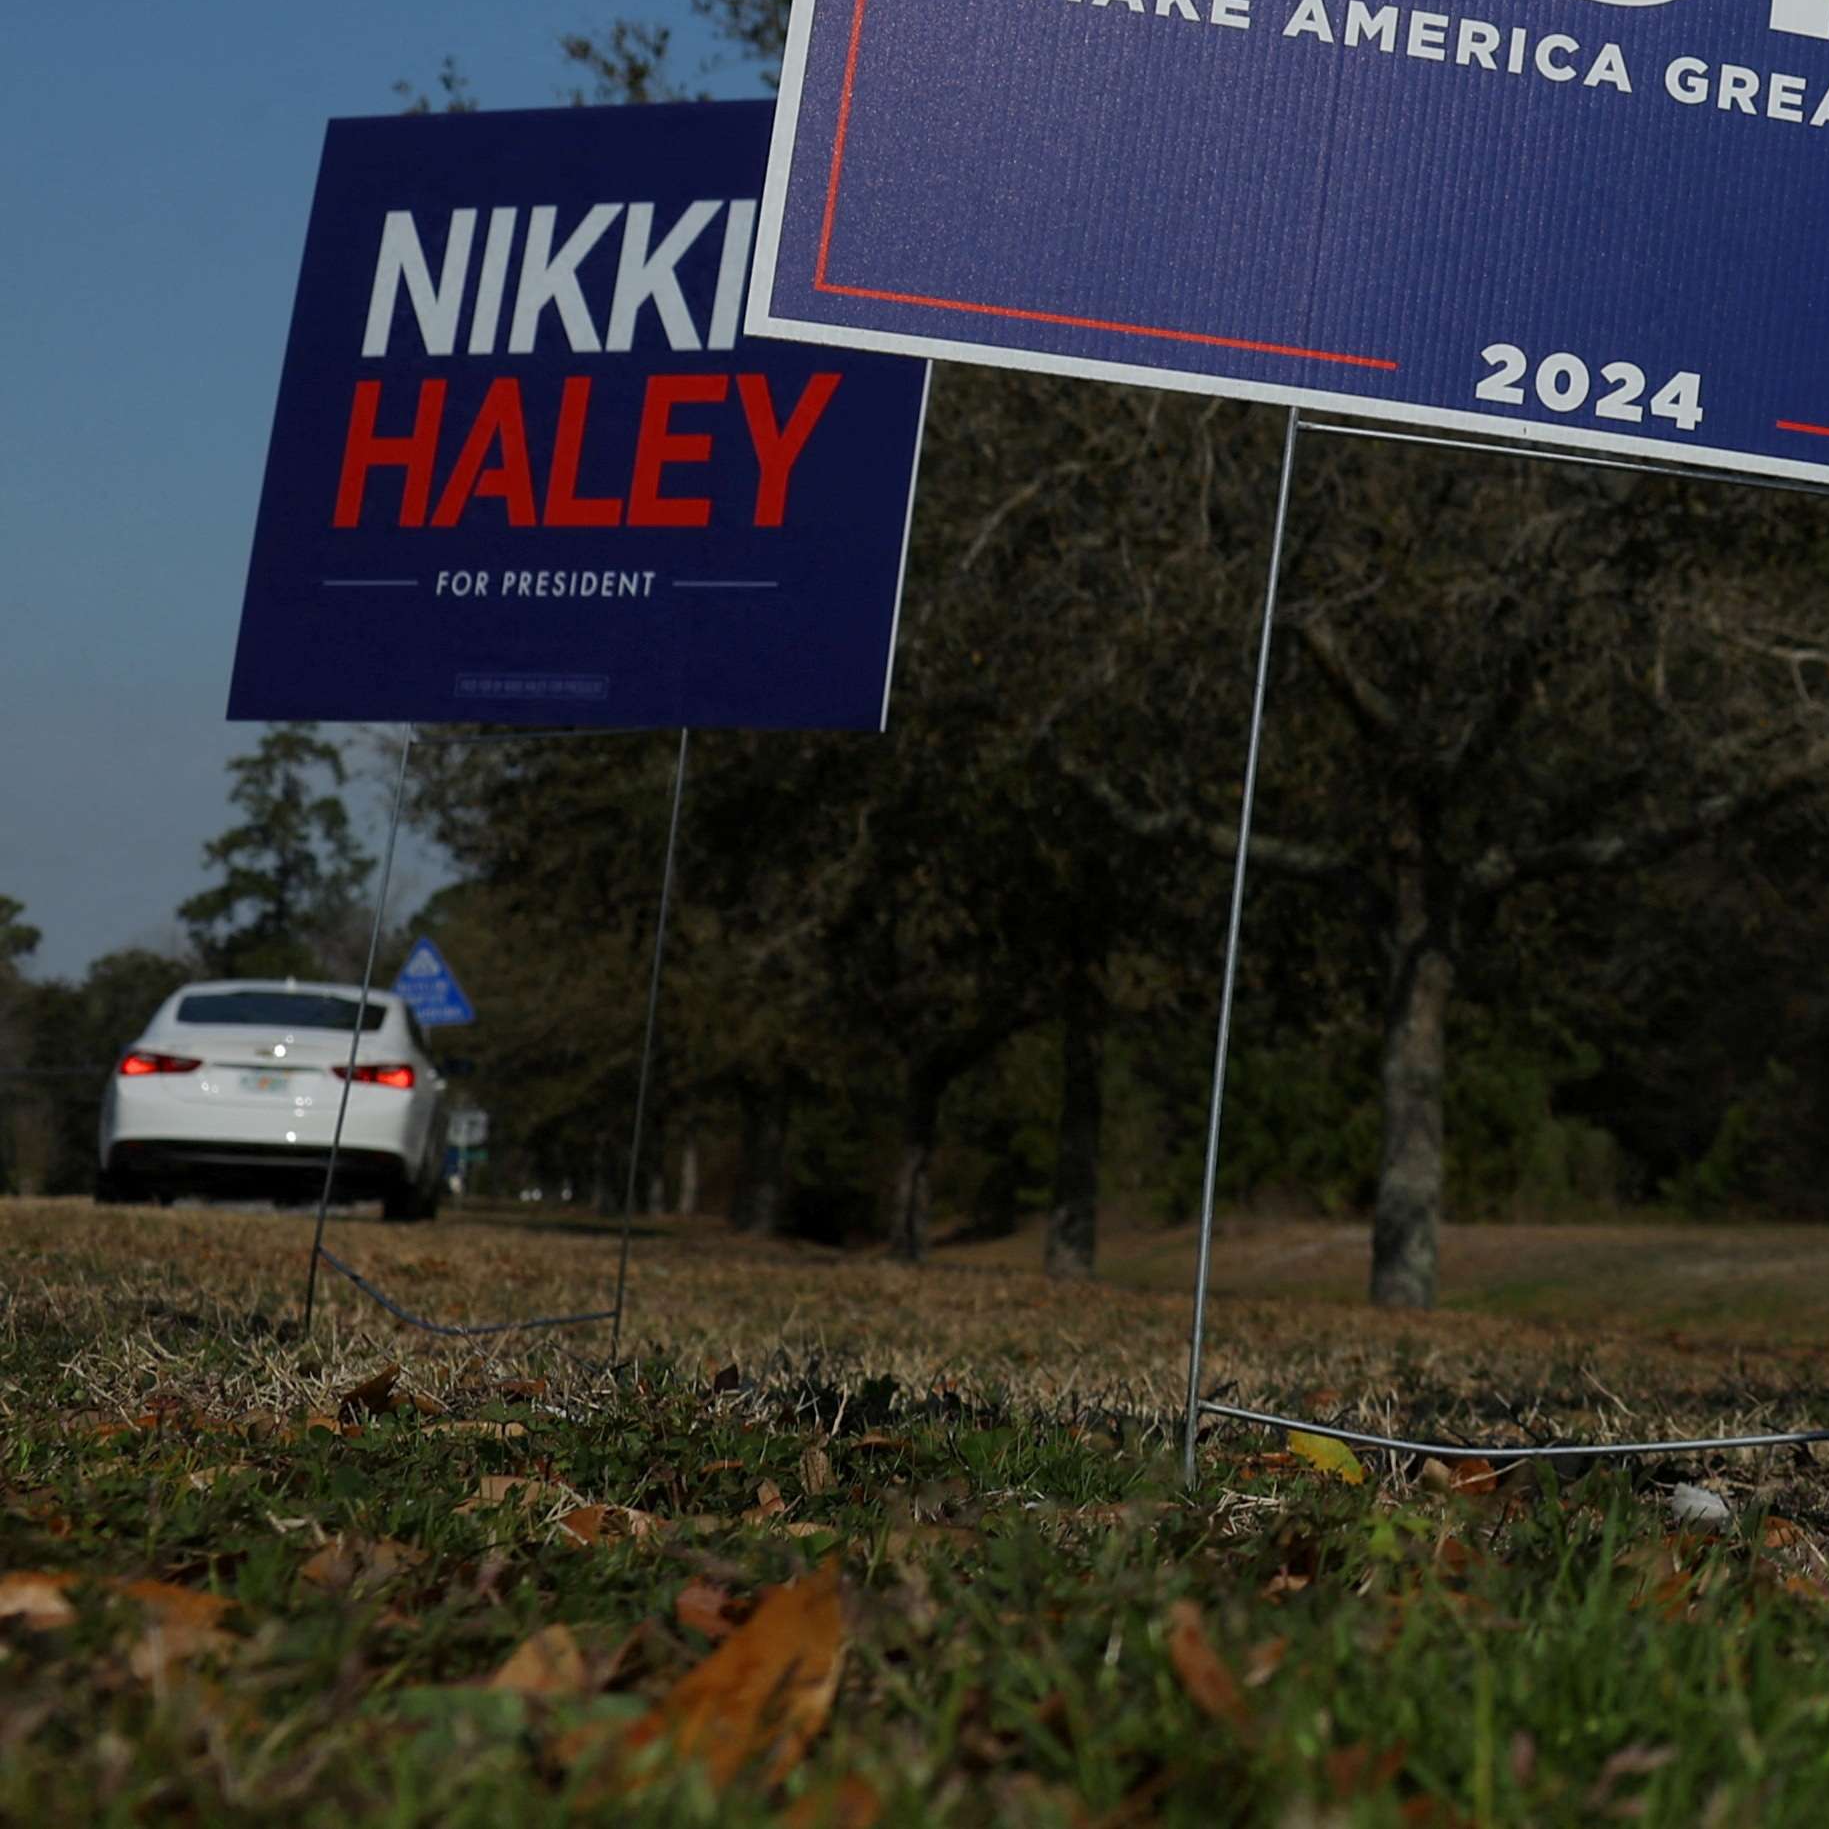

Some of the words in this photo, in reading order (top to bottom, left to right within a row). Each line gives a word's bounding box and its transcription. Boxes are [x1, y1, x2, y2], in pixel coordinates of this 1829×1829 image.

[361, 199, 757, 358] NIKKI
[1475, 342, 1704, 432] 2024
[332, 373, 842, 528] HALEY
[436, 571, 488, 597] FOR
[502, 571, 655, 597] PRESIDENT
